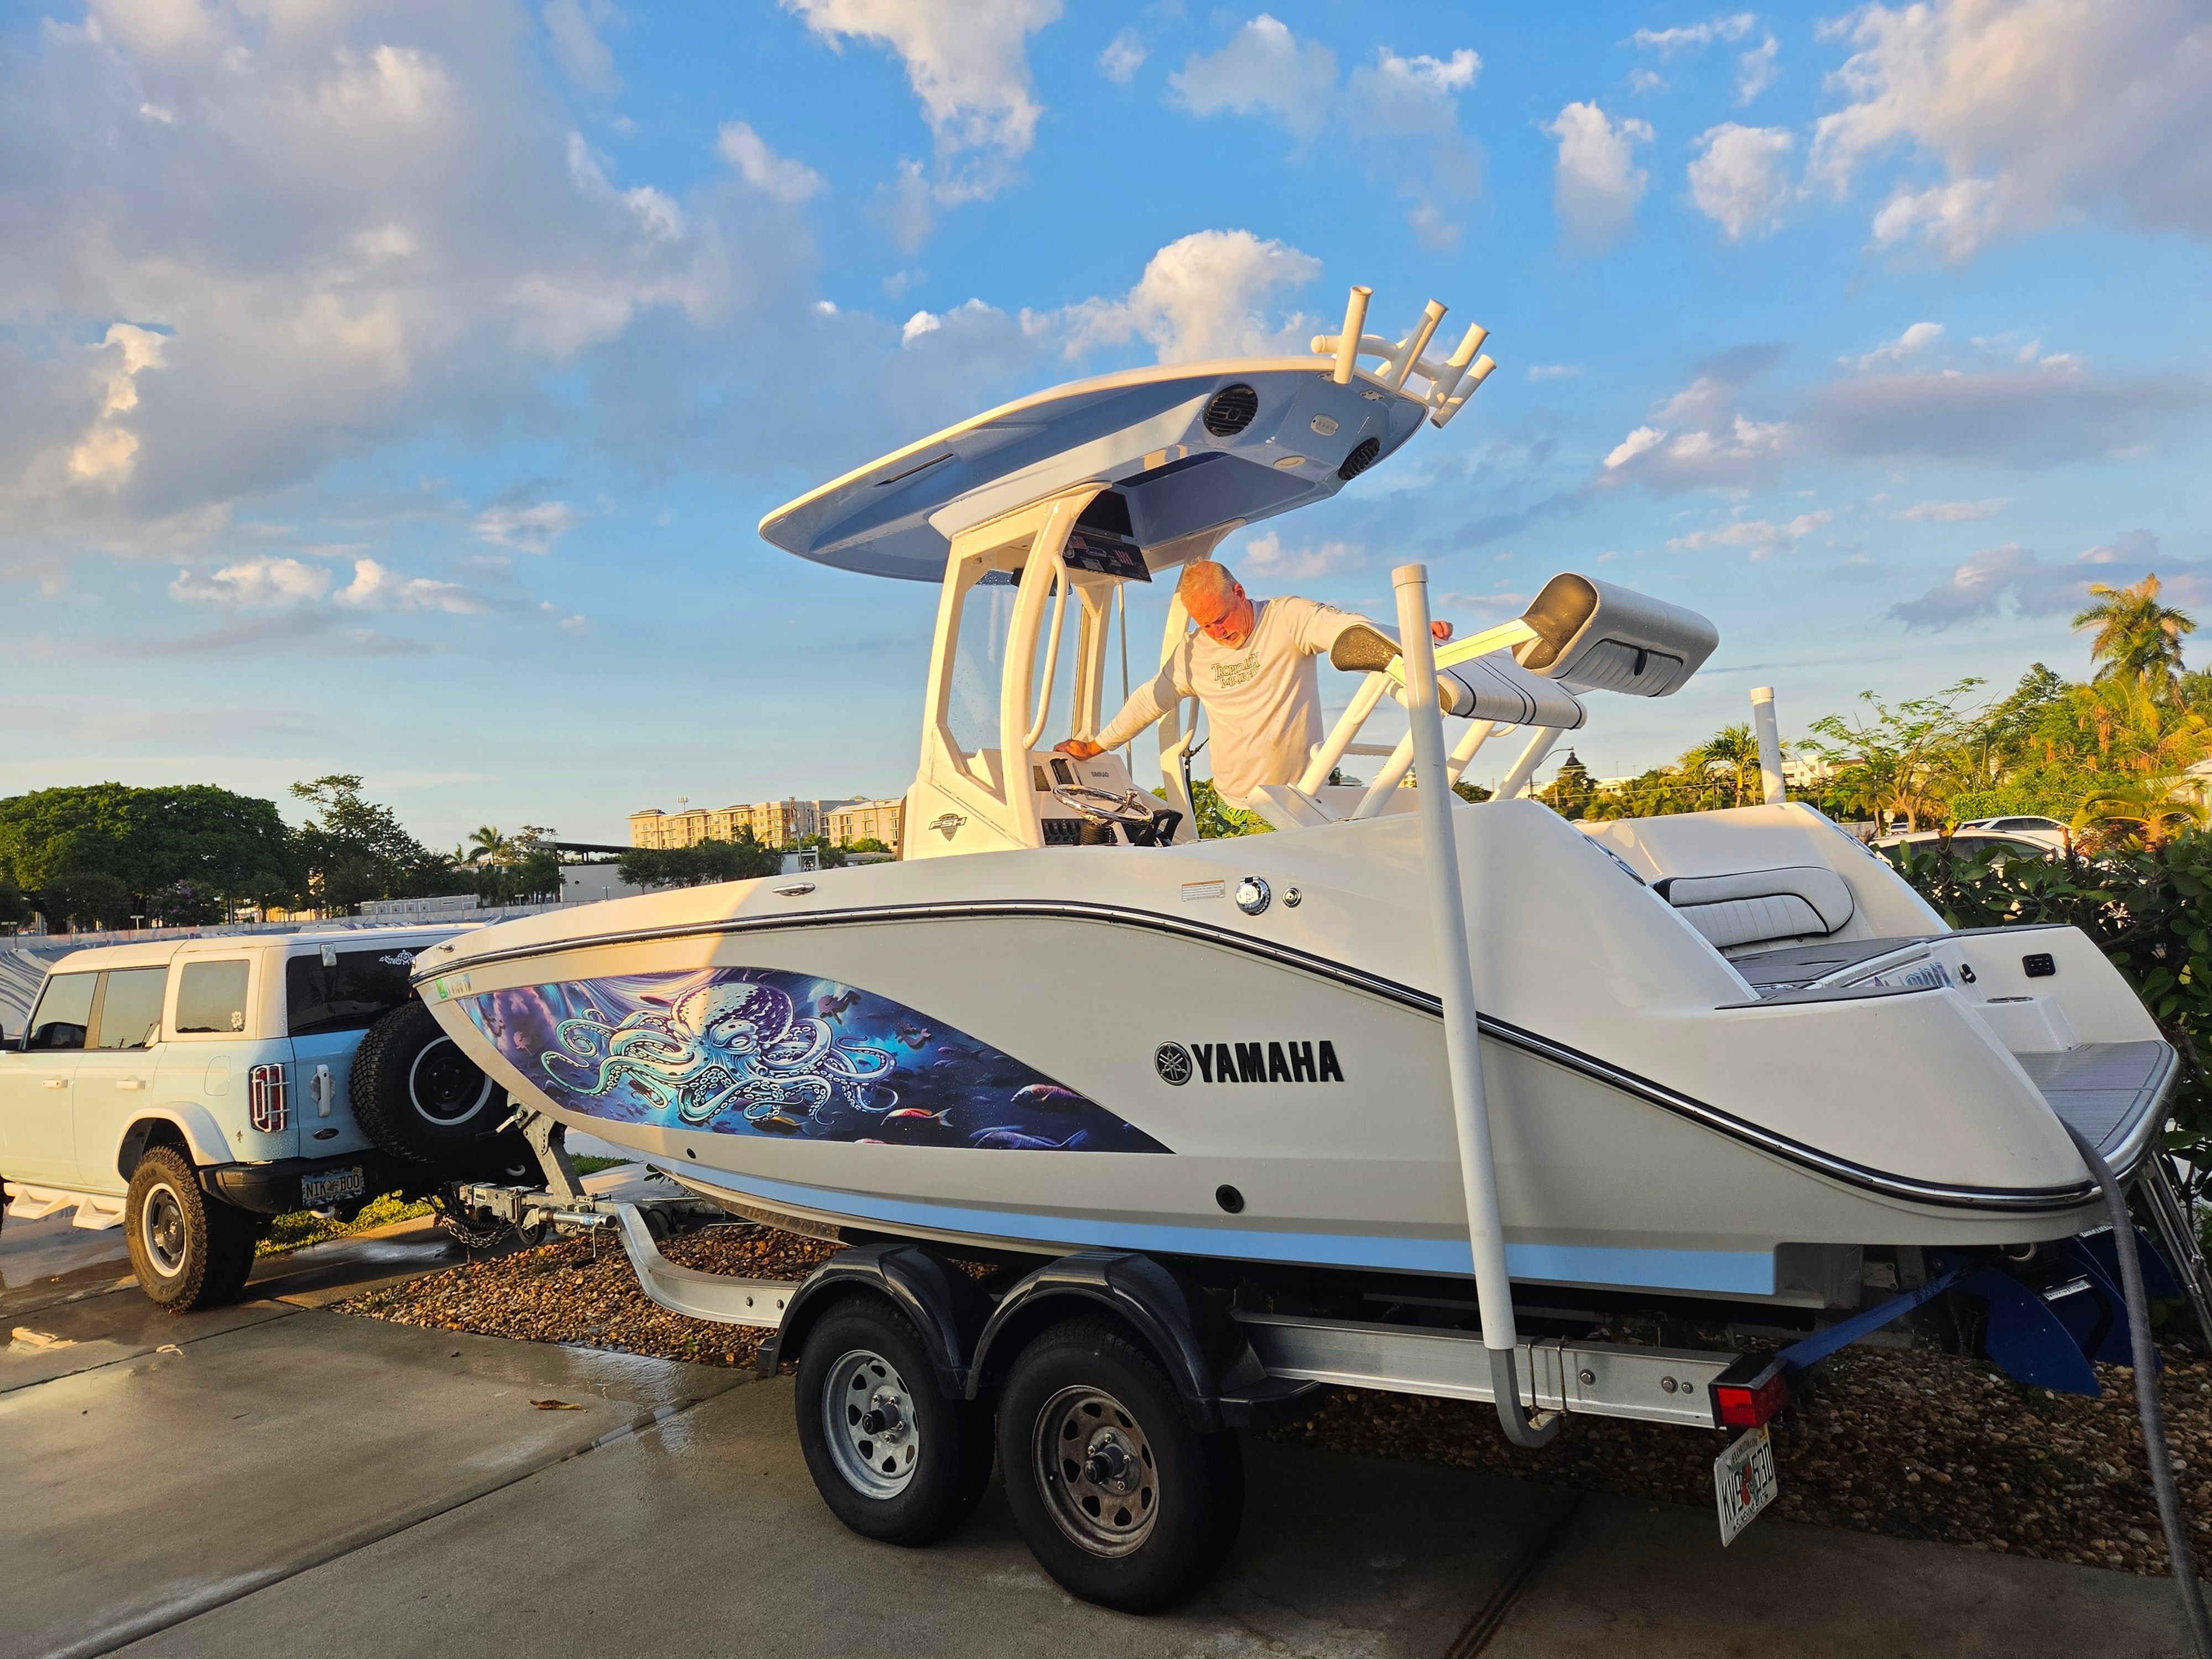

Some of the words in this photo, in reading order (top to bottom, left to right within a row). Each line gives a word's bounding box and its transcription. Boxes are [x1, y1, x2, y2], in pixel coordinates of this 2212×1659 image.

[1211, 651, 1260, 681] TROPICALLY
[1220, 667, 1258, 688] IMPAIRED
[928, 817, 967, 830] FSH
[1191, 1040, 1344, 1082] YAMAHA
[306, 1180, 326, 1198] NIK
[340, 1174, 359, 1191] BOO
